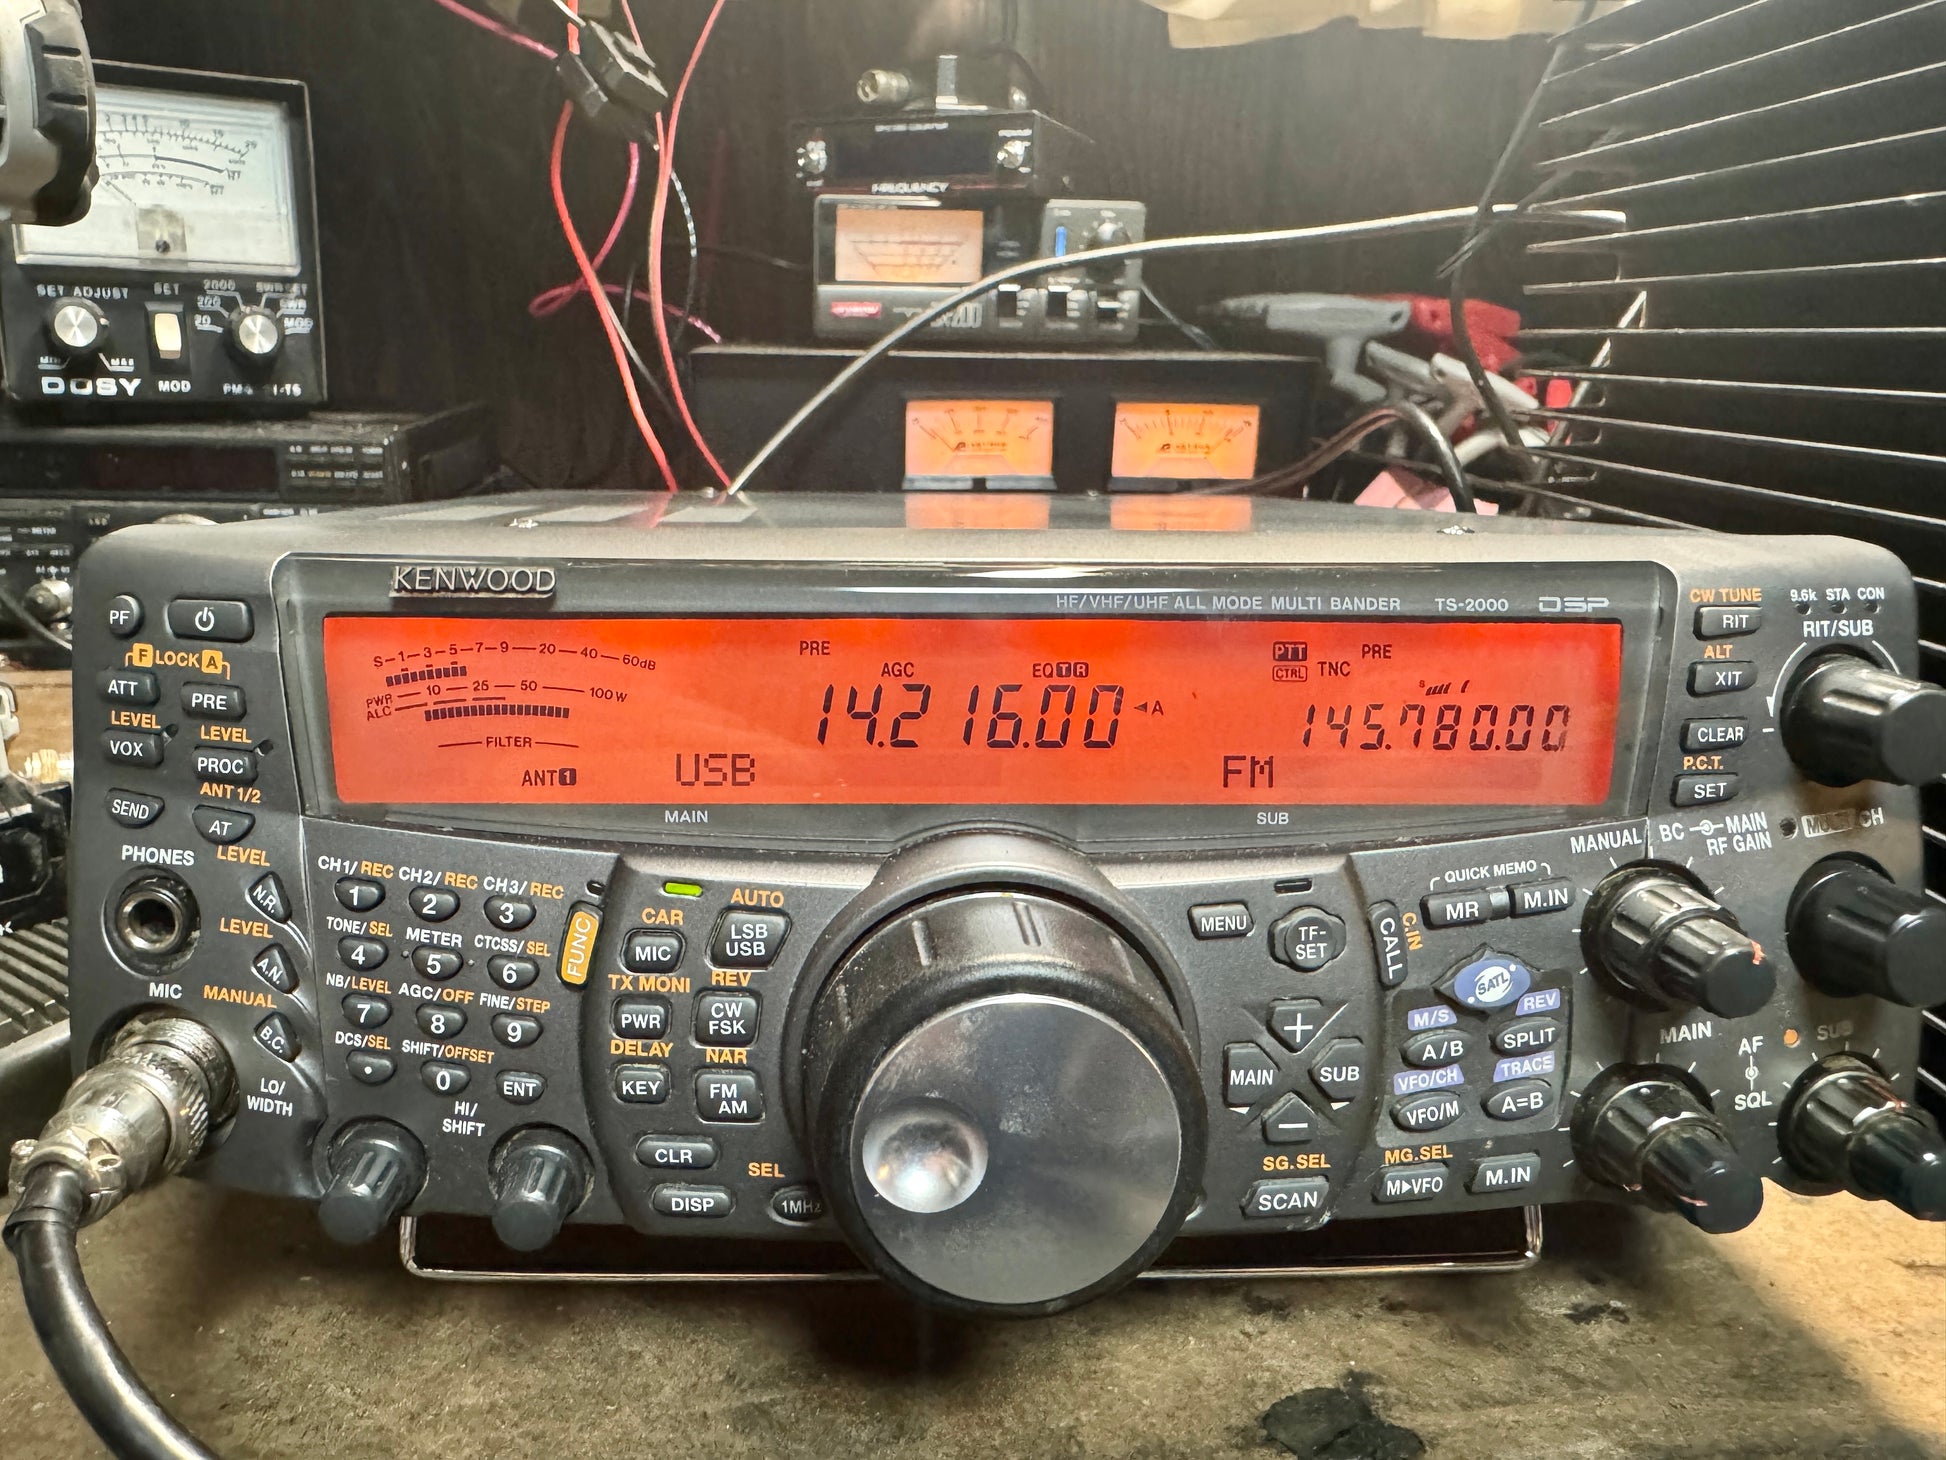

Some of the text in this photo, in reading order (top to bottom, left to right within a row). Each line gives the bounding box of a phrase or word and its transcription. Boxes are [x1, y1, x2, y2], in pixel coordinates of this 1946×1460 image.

[153, 282, 180, 295] SET
[158, 380, 191, 393] MOD
[393, 565, 556, 592] KENWOOD
[1056, 595, 1401, 611] HF/VHF/UHF ALL MODE MULTI BANDER
[1690, 588, 1762, 603] CW TUNE
[1790, 587, 1885, 602] 9.6k STA CON
[1434, 598, 1510, 613] TS-2000
[1538, 596, 1610, 613] DSP
[109, 610, 131, 625] PF
[1722, 614, 1750, 629] RIT
[1803, 619, 1875, 638] RIT/SUB
[538, 643, 557, 655] 20
[580, 647, 598, 659] 40
[799, 640, 831, 656] PRE
[1274, 643, 1307, 661] PTT
[1361, 643, 1393, 659] PRE
[1704, 644, 1734, 659] ALT
[154, 650, 200, 667] LOCK
[880, 662, 915, 678] AGC
[1275, 667, 1305, 680] CTRL
[1317, 661, 1351, 677] TNC
[1715, 671, 1743, 686] XIT
[108, 679, 138, 696] ATT
[365, 693, 393, 708] PWR
[426, 684, 441, 696] 10
[520, 680, 537, 691] 50
[191, 692, 228, 711] PRE
[110, 710, 162, 729] LEVEL
[366, 705, 392, 721] ALC
[815, 683, 1125, 749] 14.216.00
[200, 724, 252, 744] LEVEL
[1301, 703, 1570, 752] 145.780.00
[1697, 727, 1744, 743] CLEAR
[109, 740, 144, 757] VOX
[485, 736, 533, 749] FILTER
[197, 757, 244, 775] PROC
[675, 753, 756, 787] USB
[1222, 755, 1274, 788] FM
[1683, 756, 1724, 770] P.C.T.
[200, 782, 262, 804] ANT 1/2
[1693, 784, 1727, 799] SET
[111, 799, 150, 820] SEND
[664, 810, 709, 824] MAIN
[1257, 812, 1289, 826] SUB
[1858, 807, 1885, 828] CH
[208, 819, 233, 836] AT
[1659, 811, 1768, 842] BC MAIN
[1570, 828, 1643, 854] MANUAL
[1706, 831, 1773, 857] RF GAIN
[121, 845, 195, 867] PHONES
[217, 844, 271, 867] LEVEL
[1444, 860, 1537, 884] QUICK MEMO
[252, 884, 277, 915] N.R.
[348, 885, 359, 906] 1
[422, 893, 437, 915] 2
[730, 888, 785, 909] AUTO
[1523, 888, 1569, 909] M.IN
[498, 902, 514, 923] 3
[641, 907, 684, 926] CAR
[1445, 901, 1480, 921] MR
[219, 916, 274, 939] LEVEL
[731, 923, 768, 940] LSB
[1201, 915, 1248, 933] MENU
[1402, 911, 1424, 951] C.IN
[405, 926, 463, 949] METER
[1298, 926, 1327, 942] TF-
[350, 944, 366, 965] 4
[566, 917, 591, 977] FUNC
[635, 946, 672, 963] MIC
[725, 940, 767, 957] USB
[1295, 944, 1328, 960] SET
[1379, 917, 1404, 981] CALL
[256, 957, 282, 985] A.N.
[426, 953, 442, 975] 5
[502, 963, 517, 984] 6
[325, 972, 392, 995] NB/LEVEL
[608, 973, 691, 993] TX MONI
[711, 971, 752, 987] REV
[1476, 970, 1510, 996] SATL
[149, 982, 183, 1000] MIC
[203, 984, 278, 1009] MANUAL
[398, 982, 475, 1005] AGC/OFF
[479, 992, 551, 1014] FINE/STEP
[711, 1002, 743, 1019] CW
[1523, 993, 1557, 1011] REV
[356, 1003, 371, 1024] 7
[621, 1013, 661, 1030] PWR
[1413, 1009, 1450, 1028] M/S
[430, 1014, 446, 1034] 8
[506, 1022, 522, 1043] 9
[709, 1020, 747, 1035] FSK
[1660, 1021, 1714, 1045] MAIN
[1816, 1020, 1853, 1041] SUB
[259, 1026, 285, 1054] B.C.
[335, 1030, 392, 1051] DCS/SEL
[1503, 1027, 1556, 1048] SPLIT
[1738, 1035, 1764, 1056] AF
[401, 1040, 495, 1065] SHIFT/OFFSET
[610, 1040, 674, 1058] DELAY
[705, 1048, 748, 1065] NAR
[1421, 1040, 1464, 1061] A/B
[1319, 1066, 1360, 1082] SUB
[1500, 1054, 1553, 1076] TRACE
[260, 1077, 286, 1096] LO/
[435, 1070, 451, 1091] 0
[1229, 1069, 1274, 1086] MAIN
[1397, 1069, 1460, 1091] VFO/CH
[503, 1081, 537, 1097] ENT
[621, 1080, 661, 1096] KEY
[709, 1084, 738, 1099] FM
[247, 1095, 293, 1118] WIDTH
[454, 1100, 479, 1117] HI/
[718, 1100, 748, 1115] AM
[1501, 1091, 1544, 1113] A=B
[1734, 1093, 1773, 1111] SQL
[1406, 1101, 1460, 1125] VFO/M
[442, 1118, 486, 1137] SHIFT
[654, 1149, 693, 1164] CLR
[1262, 1154, 1331, 1171] SG.SEL
[1384, 1145, 1453, 1164] MG.SEL
[748, 1162, 786, 1178] SEL
[1485, 1165, 1531, 1186] M.IN
[671, 1197, 715, 1212] DISP
[1258, 1191, 1318, 1211] SCAN
